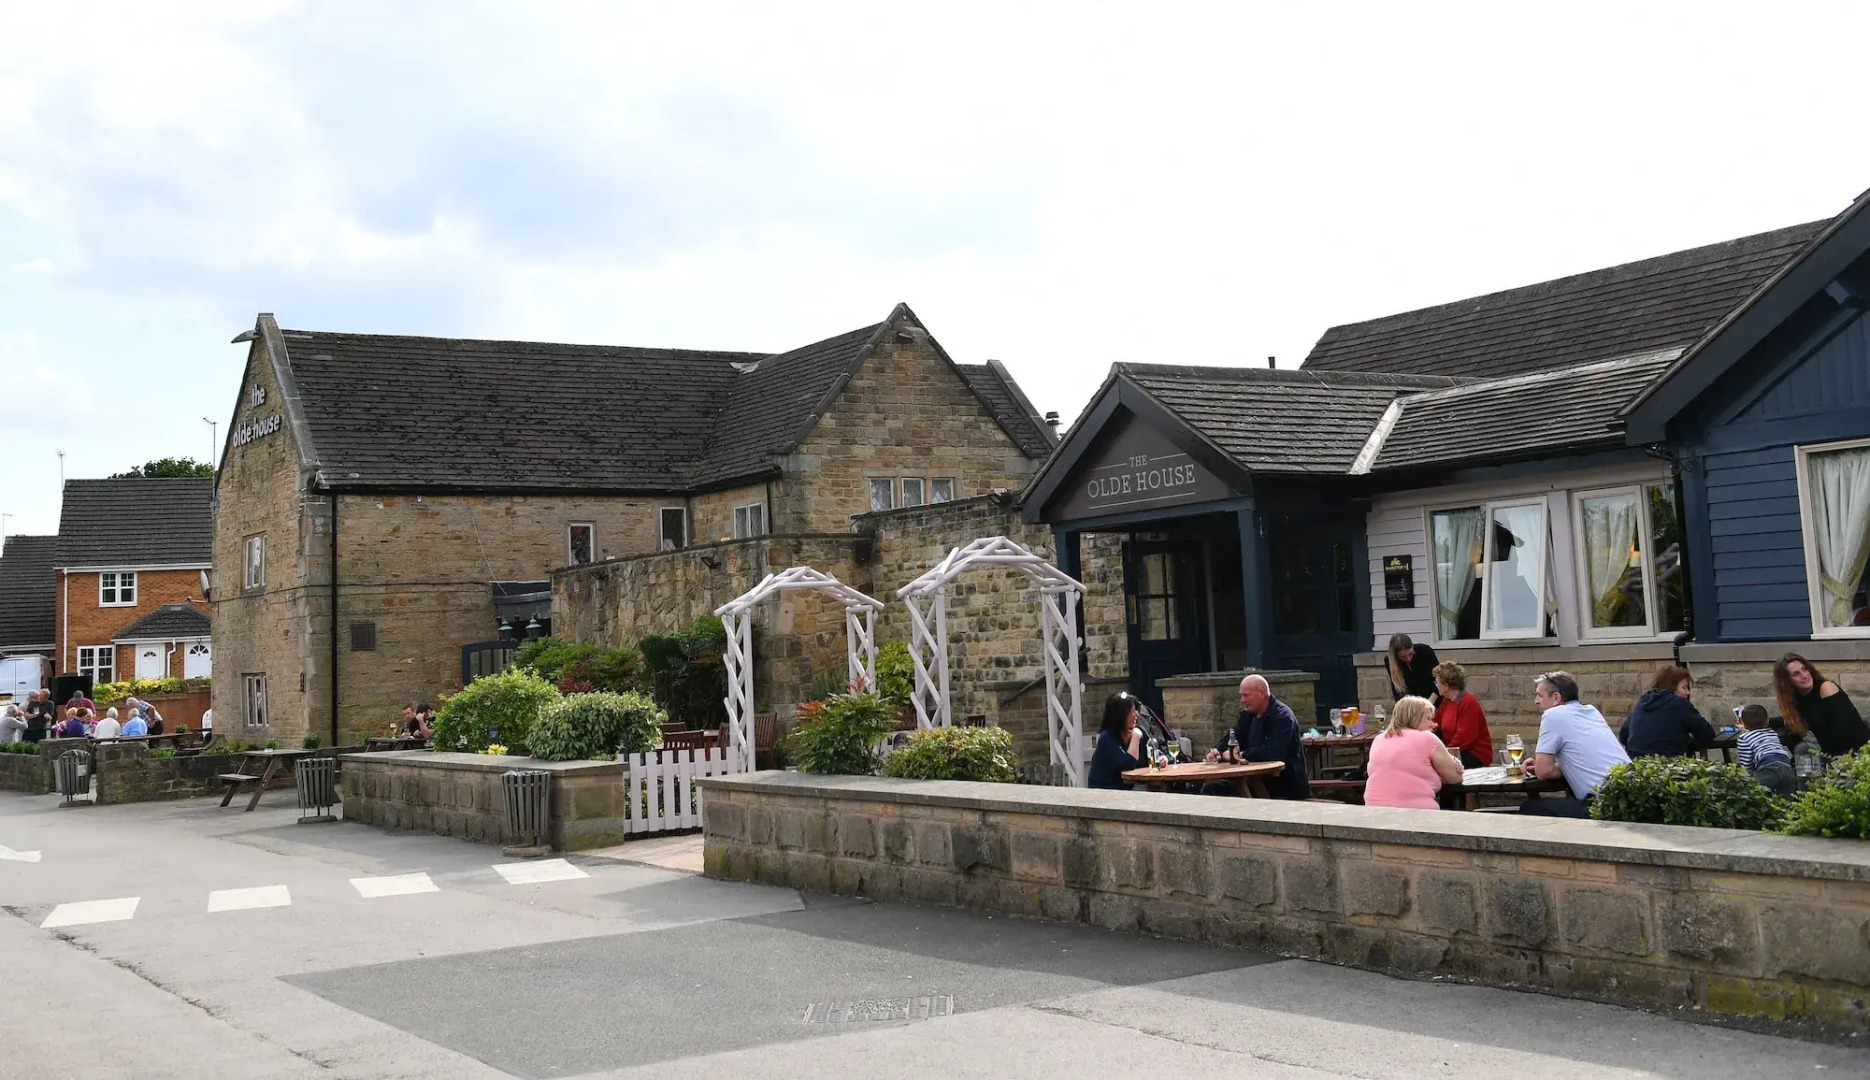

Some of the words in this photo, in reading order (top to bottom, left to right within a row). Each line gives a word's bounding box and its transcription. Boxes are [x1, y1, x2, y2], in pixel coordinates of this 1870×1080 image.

[232, 421, 252, 447] olde
[1129, 454, 1148, 468] THE
[1087, 474, 1131, 498] OLDE
[1135, 464, 1196, 492] HOUSE
